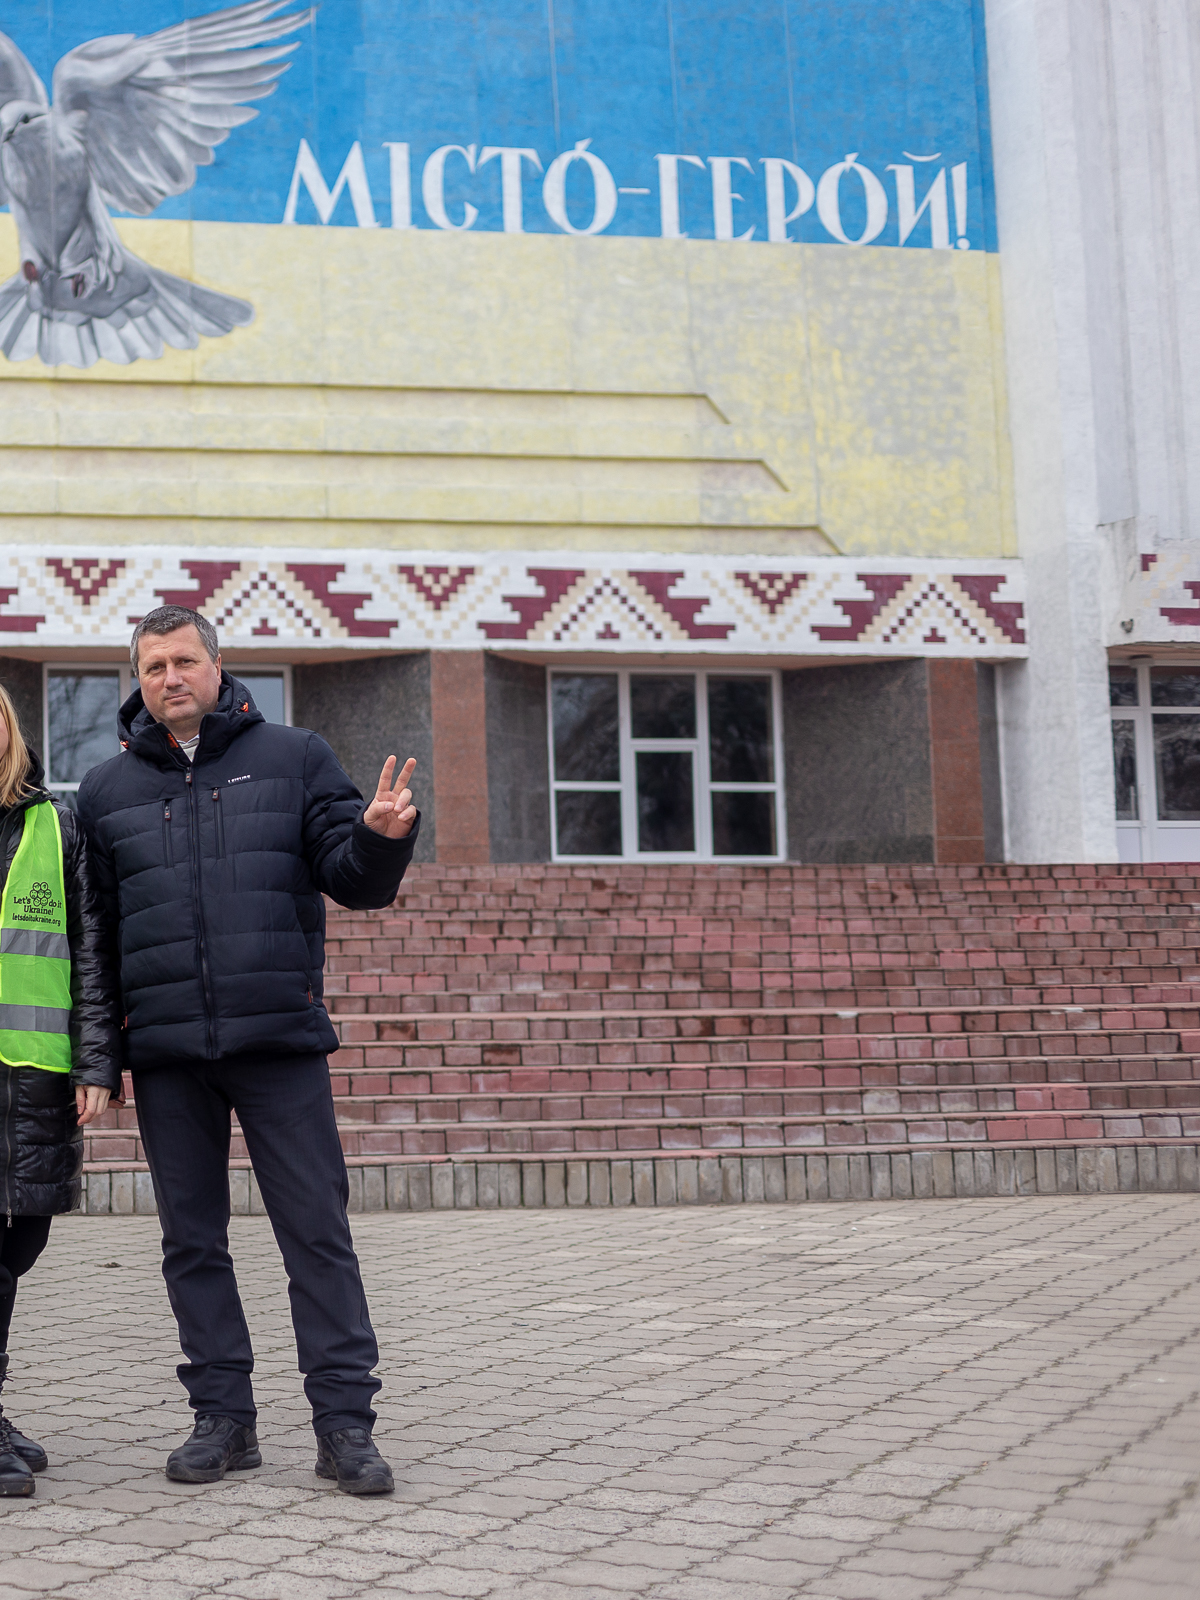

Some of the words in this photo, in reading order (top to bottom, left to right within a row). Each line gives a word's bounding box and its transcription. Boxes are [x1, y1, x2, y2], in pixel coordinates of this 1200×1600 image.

[14, 896, 31, 904] Let's
[49, 899, 57, 907] do
[24, 905, 53, 915] Ukraine!
